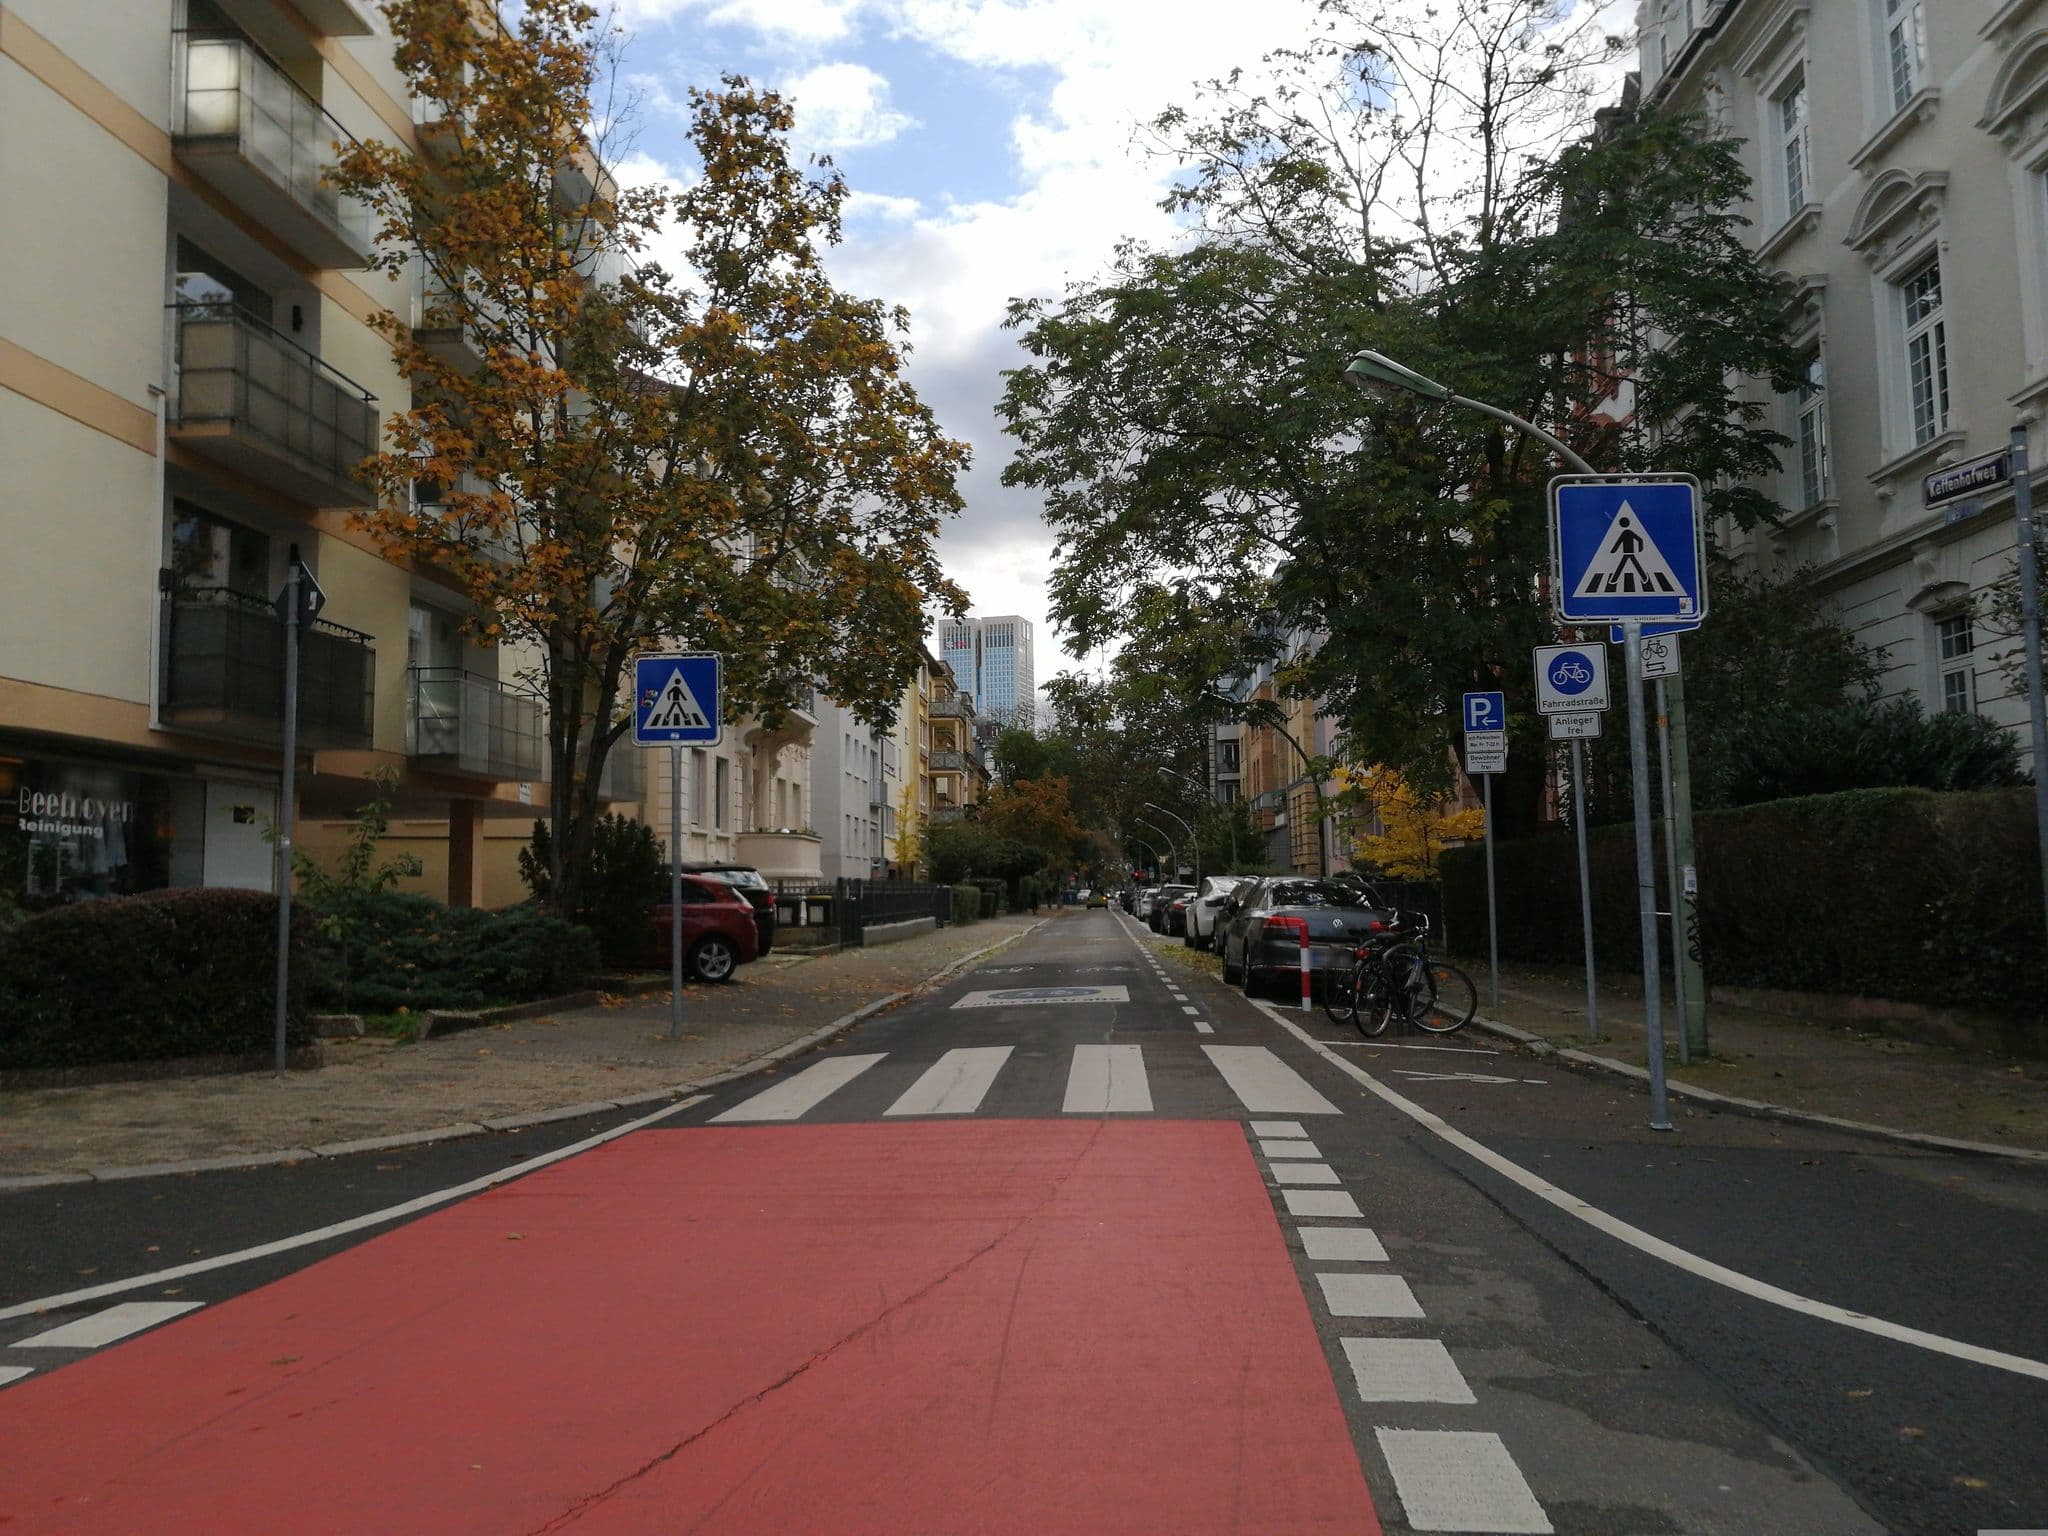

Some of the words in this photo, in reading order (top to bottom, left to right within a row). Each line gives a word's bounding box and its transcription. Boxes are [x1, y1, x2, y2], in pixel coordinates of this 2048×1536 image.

[1542, 697, 1605, 708] Fahrradstraße
[1470, 697, 1492, 727] P
[1555, 717, 1594, 726] Anlieger
[1567, 725, 1584, 735] frei
[18, 818, 104, 839] Reinigung
